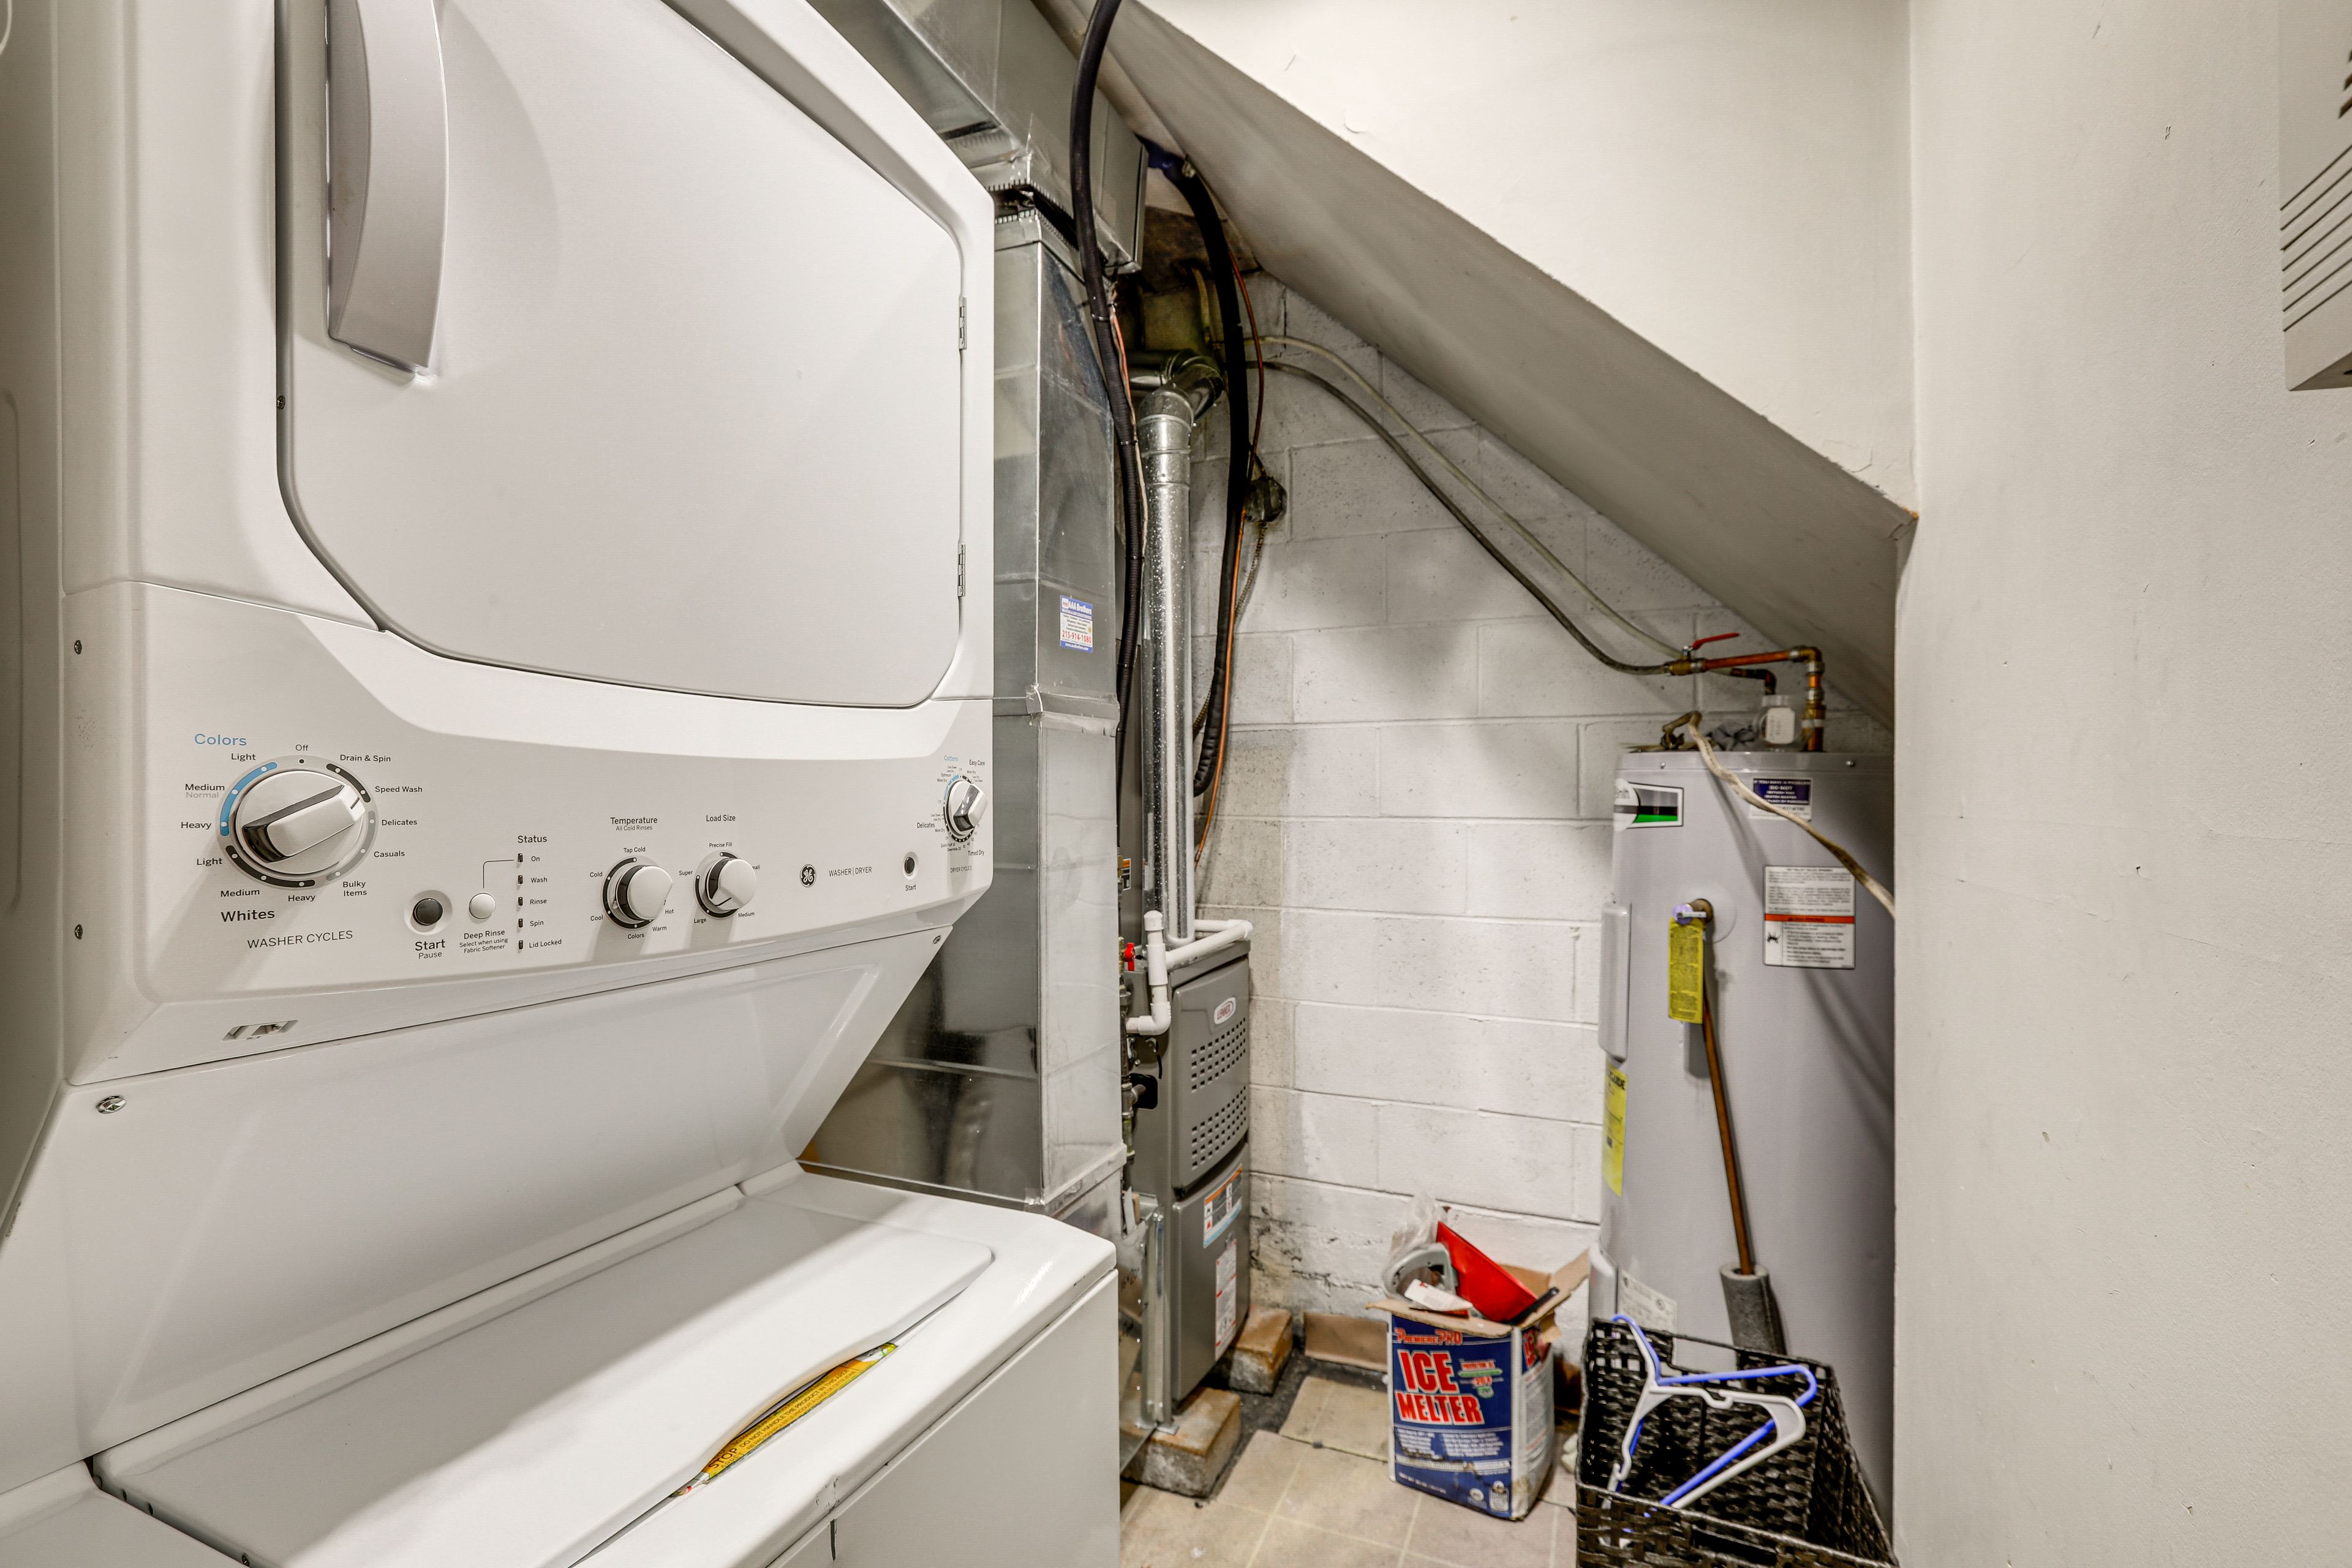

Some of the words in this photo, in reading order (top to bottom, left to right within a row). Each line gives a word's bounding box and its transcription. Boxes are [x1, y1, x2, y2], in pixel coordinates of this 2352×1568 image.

[1062, 630, 1092, 643] 215-914-1080
[194, 734, 247, 746] Colors
[231, 753, 256, 762] Light
[610, 816, 658, 825] Temperature
[181, 821, 211, 830] Heavy
[518, 835, 548, 843] Status
[197, 858, 222, 867] Light
[829, 869, 851, 877] WASHER
[342, 881, 366, 889] Bulky
[221, 889, 260, 897] Medium
[221, 909, 275, 922] Whites
[247, 935, 303, 949] WASHER
[306, 930, 353, 943] CYCLES
[415, 939, 445, 951] Start
[418, 951, 442, 959] Pause
[1398, 1349, 1460, 1394] ICE
[1395, 1390, 1485, 1425] MELTER
[708, 1448, 737, 1469] STOP
[749, 1431, 763, 1440] NOT
[761, 1415, 785, 1431] HANDLE
[794, 1390, 820, 1408] PRODUCT
